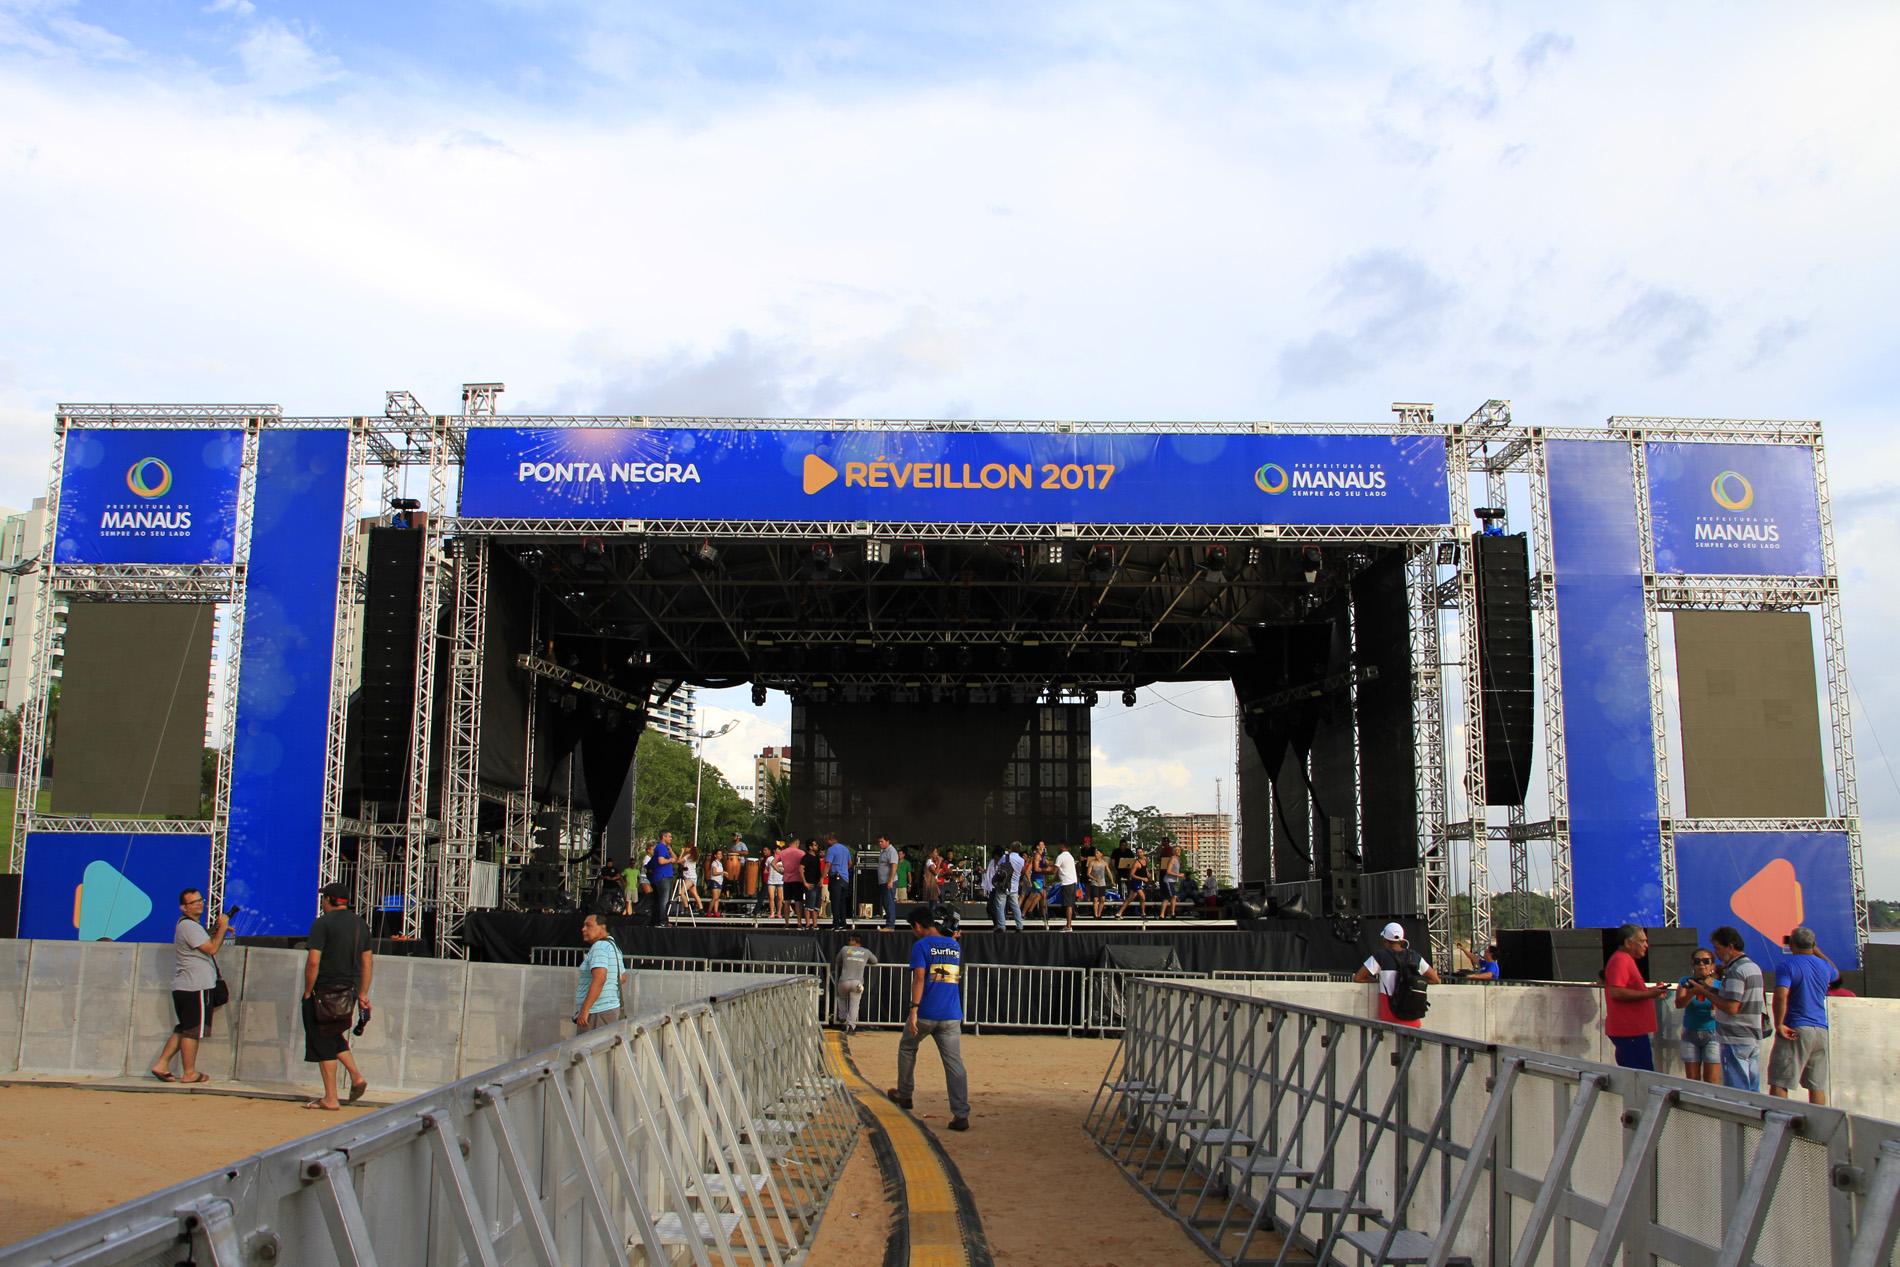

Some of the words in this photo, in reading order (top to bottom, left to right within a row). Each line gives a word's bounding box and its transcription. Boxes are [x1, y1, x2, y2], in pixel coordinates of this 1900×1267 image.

[519, 463, 605, 482] PONTA
[611, 463, 701, 483] NEGRA
[845, 456, 1033, 489] RÉVEILLON
[1041, 464, 1115, 490] 2017
[1292, 471, 1386, 488] MANAUS
[101, 512, 191, 529] MANAUS
[1694, 523, 1779, 541] MANAUS
[930, 948, 960, 958] Surfing
